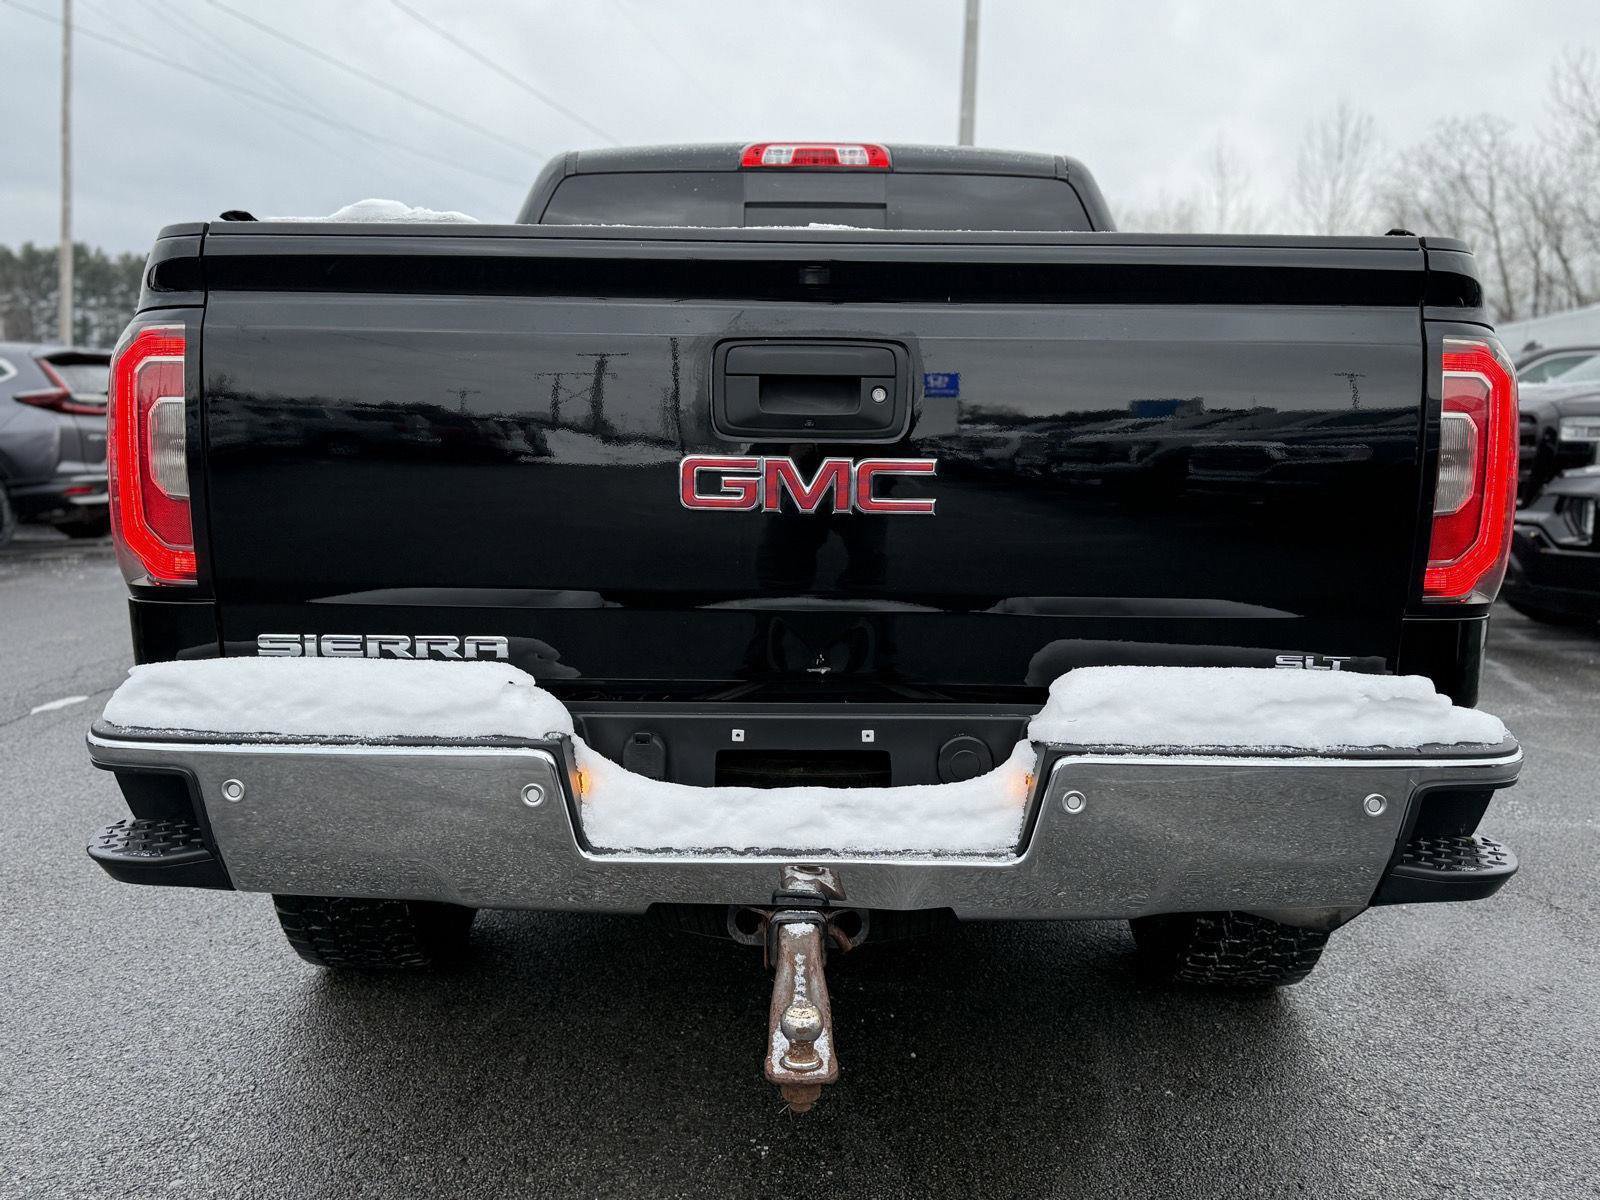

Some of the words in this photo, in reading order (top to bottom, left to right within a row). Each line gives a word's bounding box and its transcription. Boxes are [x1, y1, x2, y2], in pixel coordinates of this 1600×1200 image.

[679, 455, 937, 515] GMC
[257, 633, 509, 658] SIERRA
[1275, 655, 1351, 671] SLT
